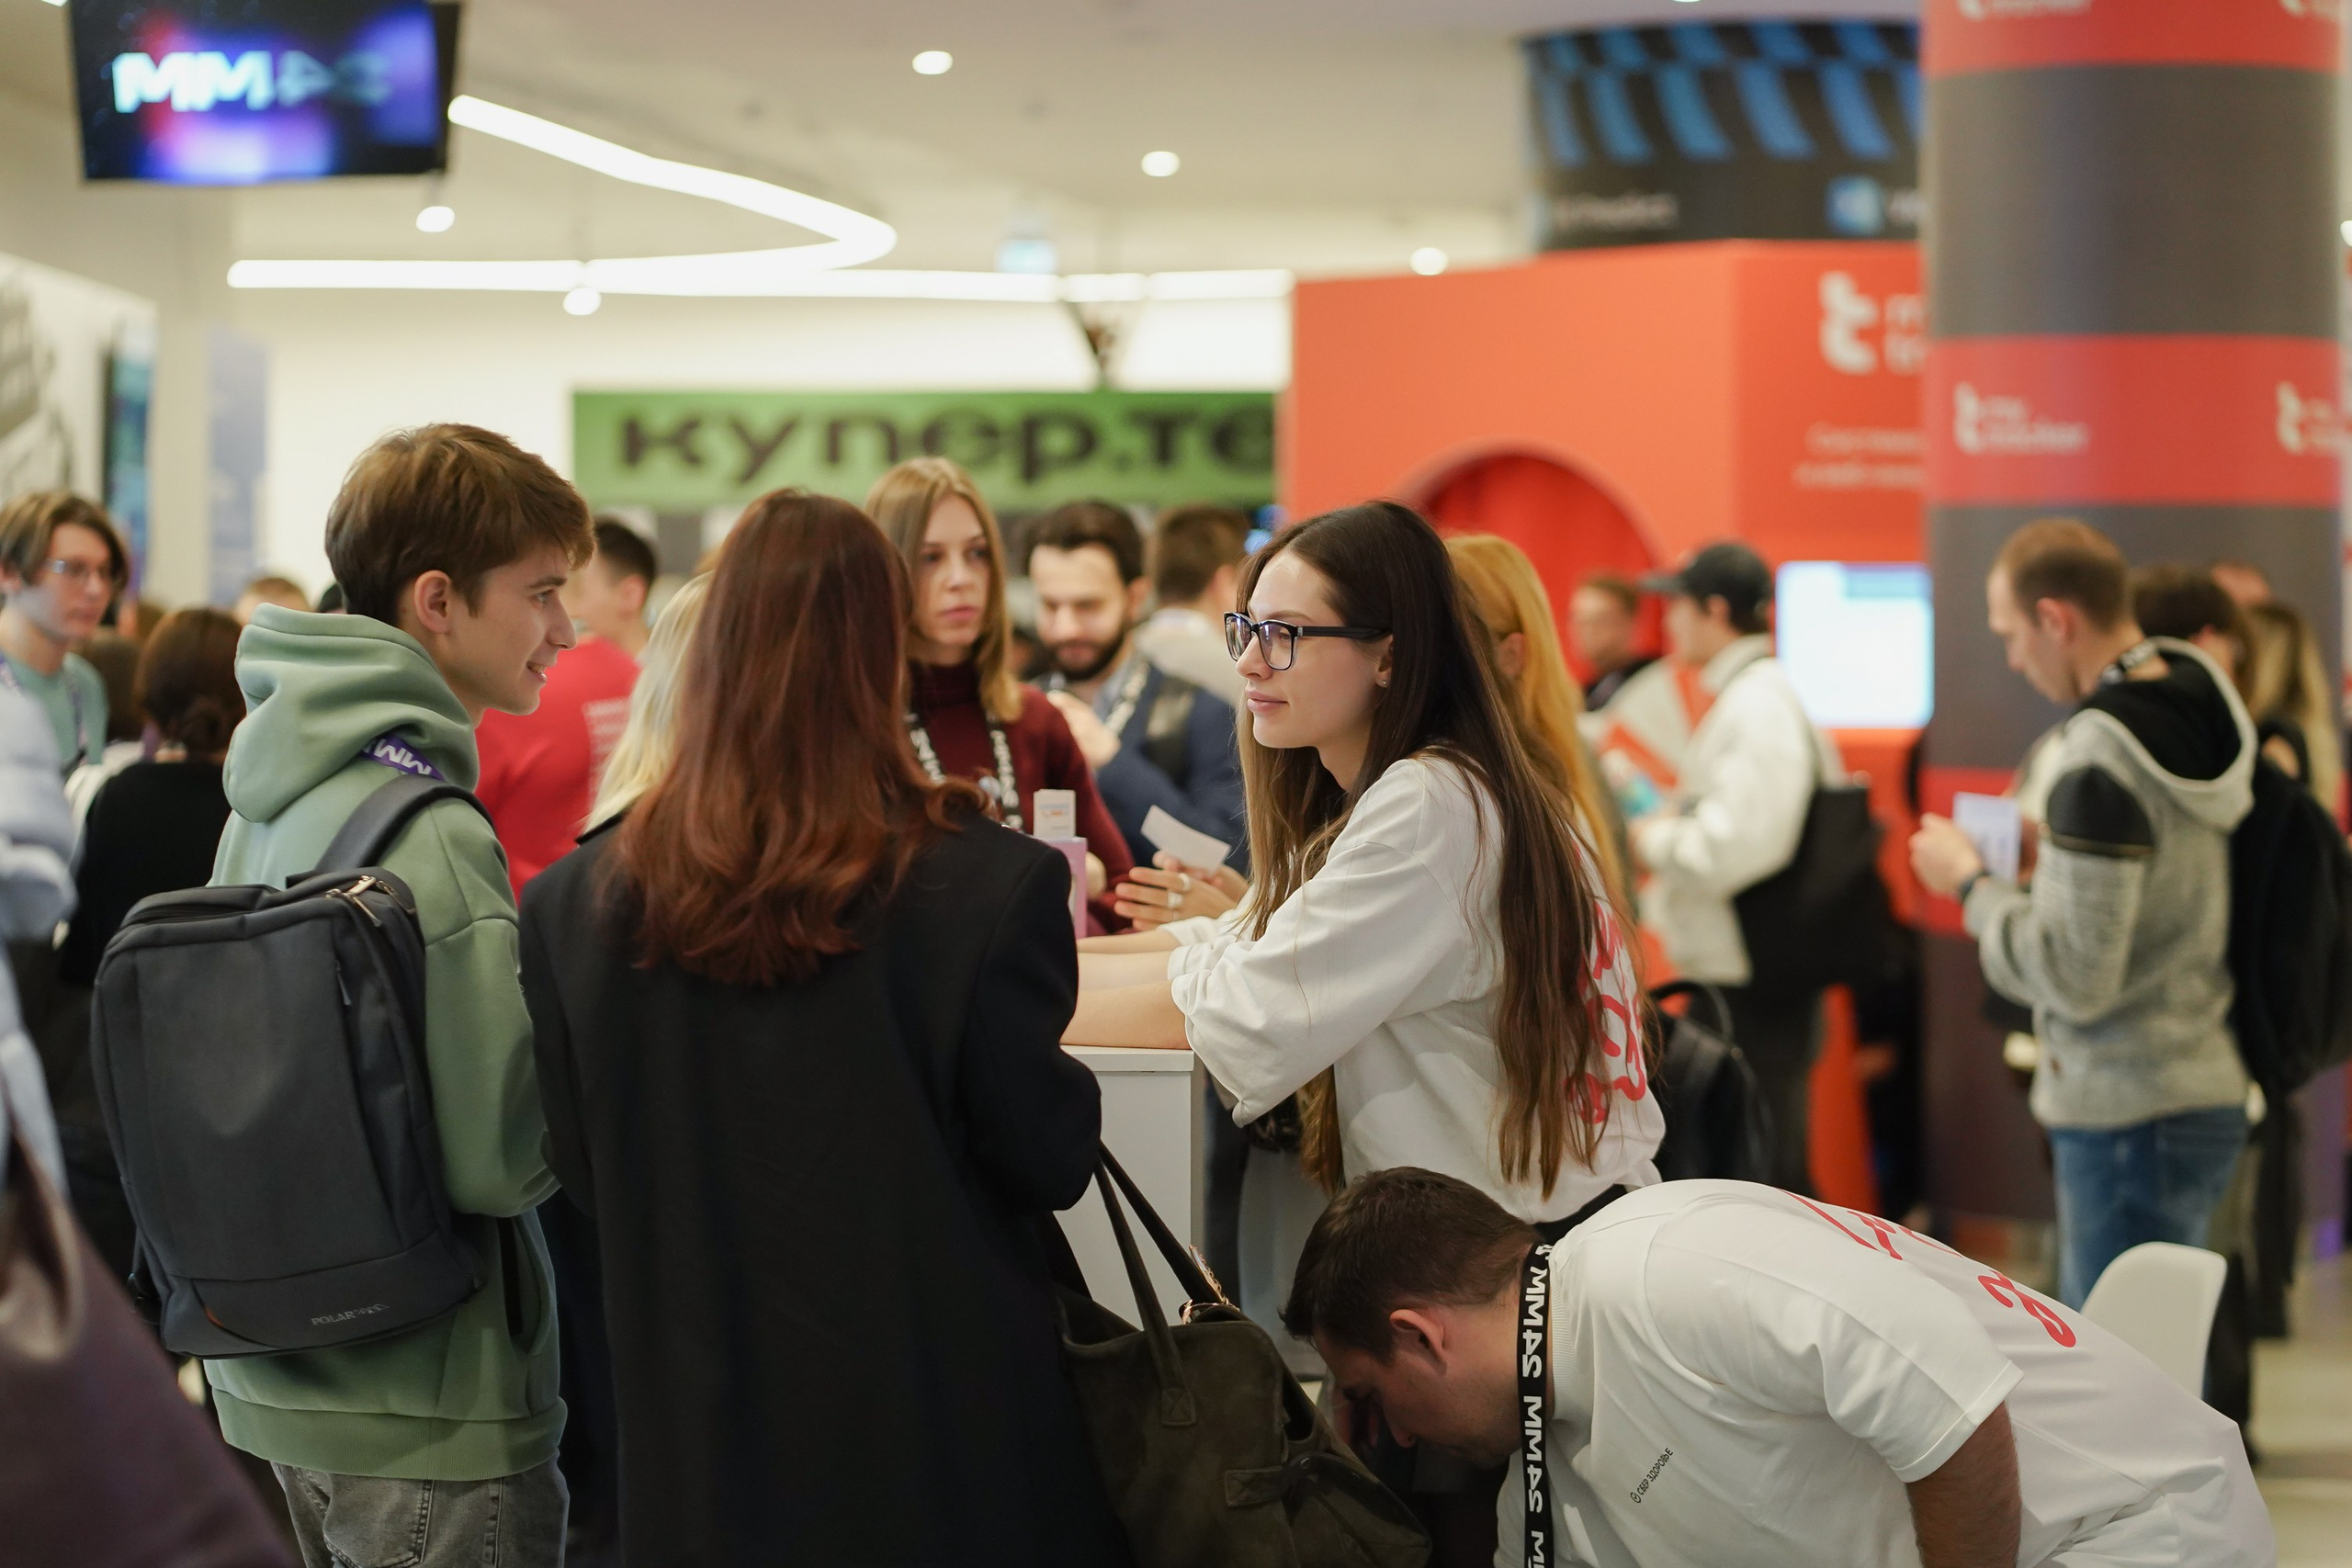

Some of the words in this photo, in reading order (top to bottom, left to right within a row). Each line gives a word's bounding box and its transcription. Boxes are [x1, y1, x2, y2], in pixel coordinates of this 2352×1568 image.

[1522, 1266, 1548, 1378] MMAS
[1523, 1395, 1544, 1514] MMAS
[1636, 1478, 1649, 1495] СБЕР
